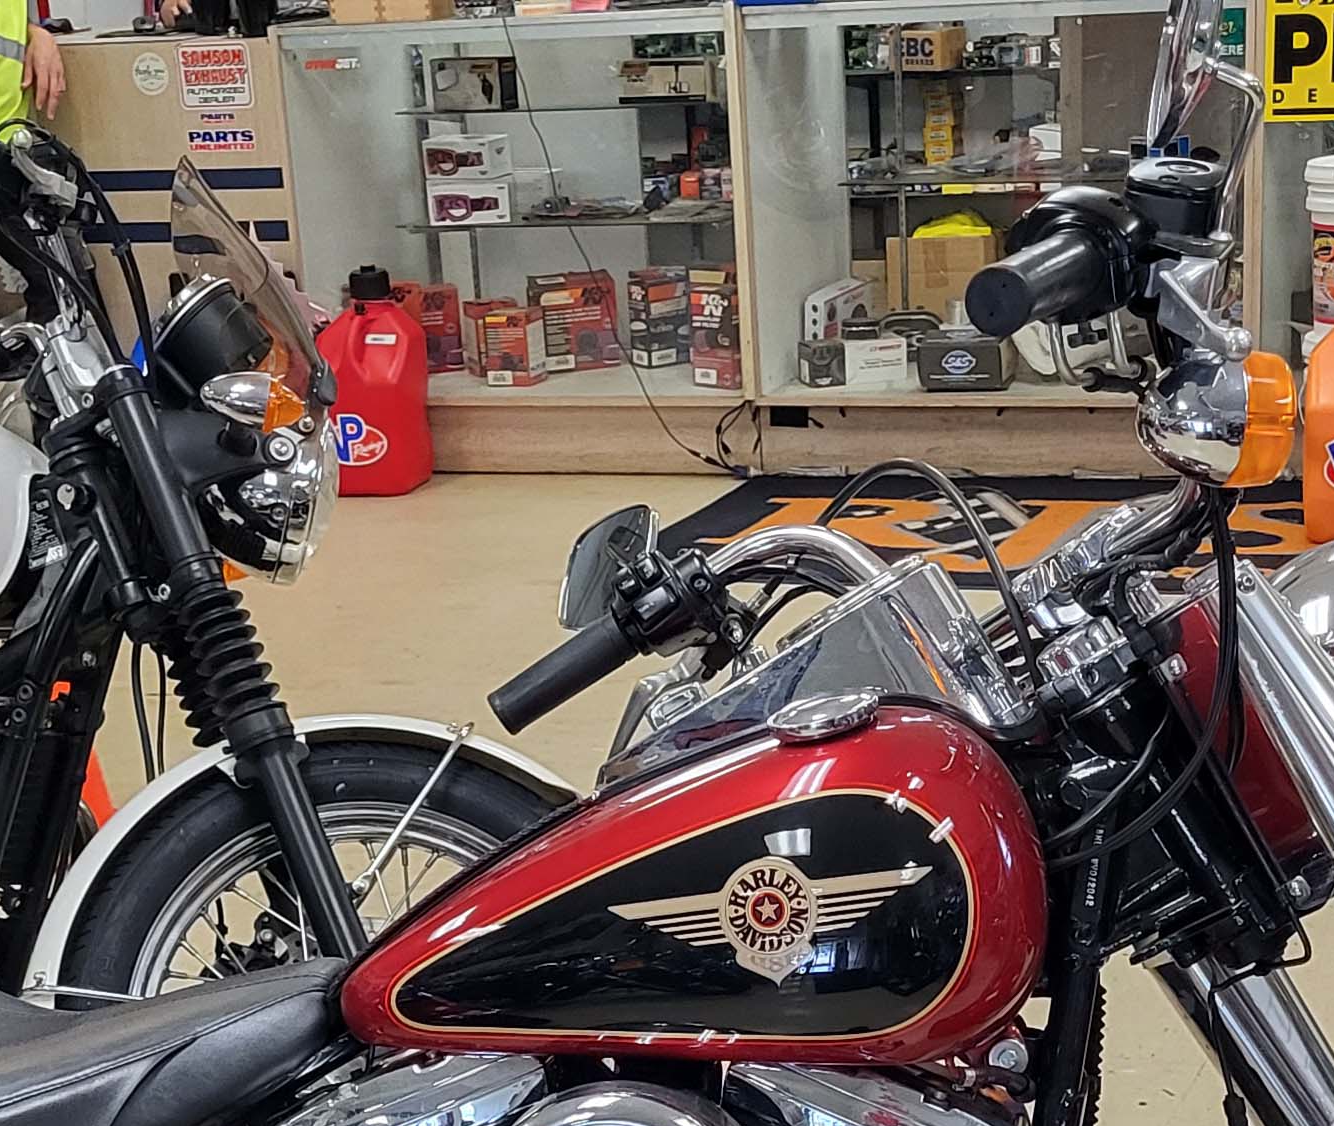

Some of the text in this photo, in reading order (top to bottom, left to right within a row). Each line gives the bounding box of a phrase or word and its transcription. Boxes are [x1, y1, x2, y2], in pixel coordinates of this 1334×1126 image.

[181, 50, 244, 66] SAMSON
[183, 68, 246, 85] EXHAUST
[187, 87, 246, 95] AUTHORIZED
[188, 130, 254, 142] PARTS
[190, 143, 255, 151] UNLIMITED
[700, 293, 729, 317] K&N
[729, 868, 809, 908] HARLEY
[729, 910, 809, 952] DAVIDSON
